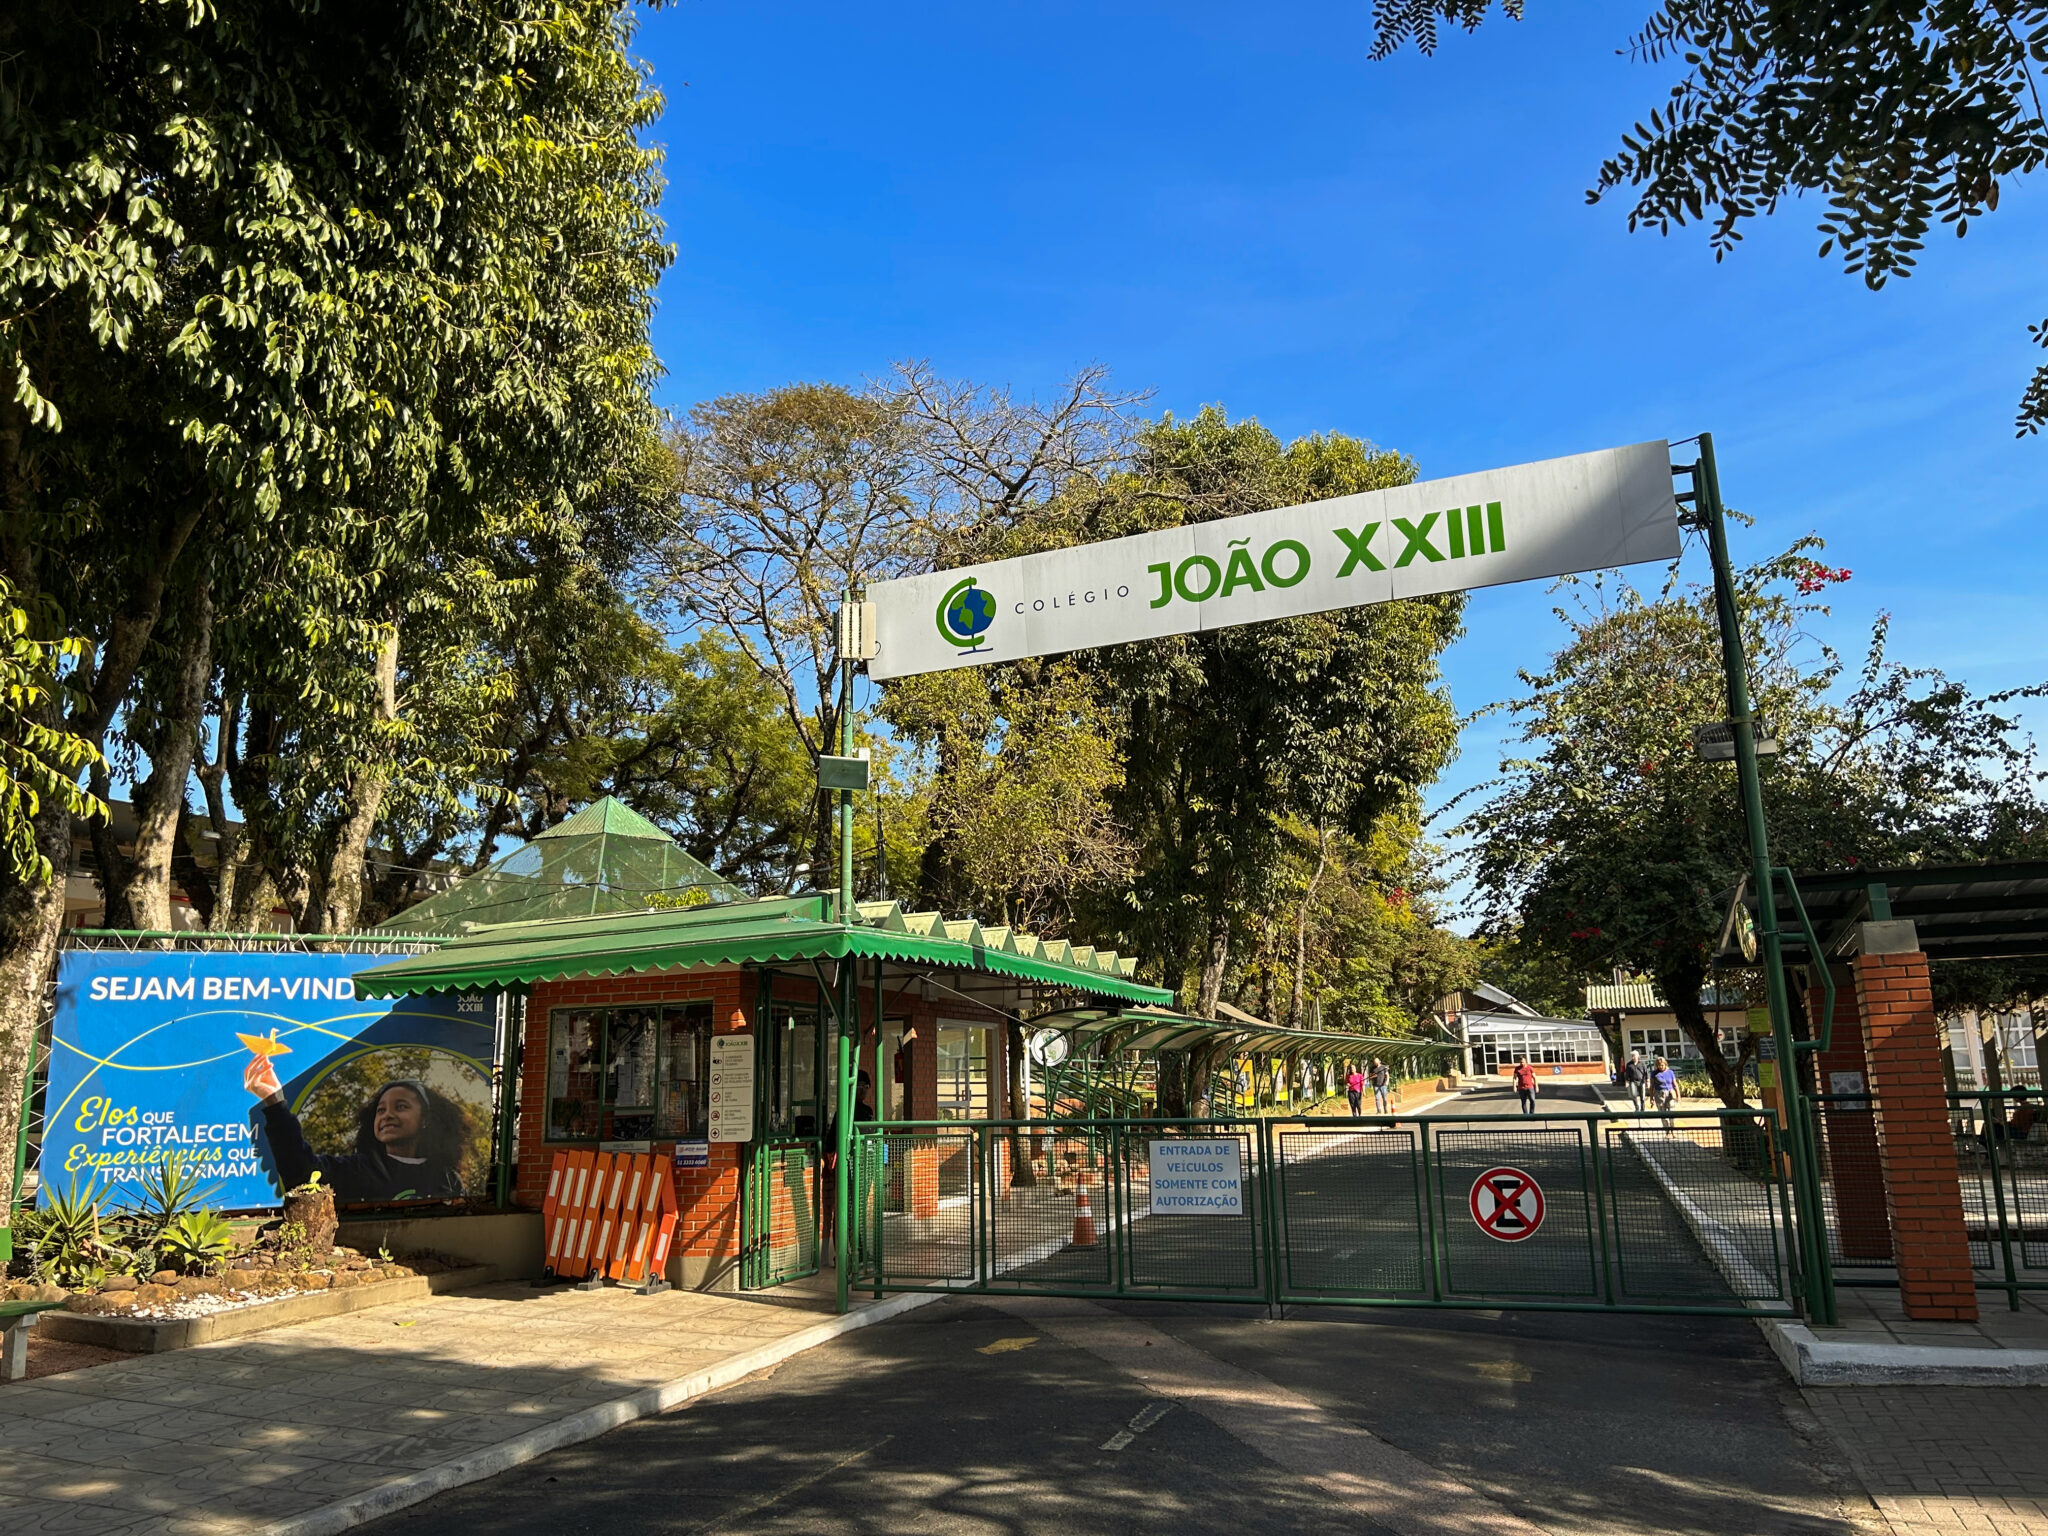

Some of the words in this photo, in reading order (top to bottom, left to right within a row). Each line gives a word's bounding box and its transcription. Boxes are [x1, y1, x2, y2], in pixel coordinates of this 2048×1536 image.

[1014, 585, 1129, 614] COLÉGIO
[1147, 537, 1311, 609] JOÃO
[1332, 501, 1506, 578] XXIII
[90, 976, 195, 1001] SEJAM
[202, 976, 394, 1001] BEM-VIND
[457, 1003, 484, 1012] XXIII
[74, 1096, 139, 1132] Elos
[142, 1111, 175, 1124] QUE
[102, 1122, 259, 1146] FORTALECEM
[227, 1147, 259, 1160] QUE
[1159, 1145, 1212, 1156] ENTRADA
[1215, 1145, 1230, 1155] DE
[100, 1161, 257, 1184] TRANSORMAM
[1167, 1160, 1224, 1173] VEÍCULOS
[1155, 1179, 1208, 1190] SOMENTE
[1211, 1179, 1237, 1189] COM
[1156, 1194, 1238, 1209] AUTORIZAÇÃO
[1493, 1180, 1526, 1228] E
